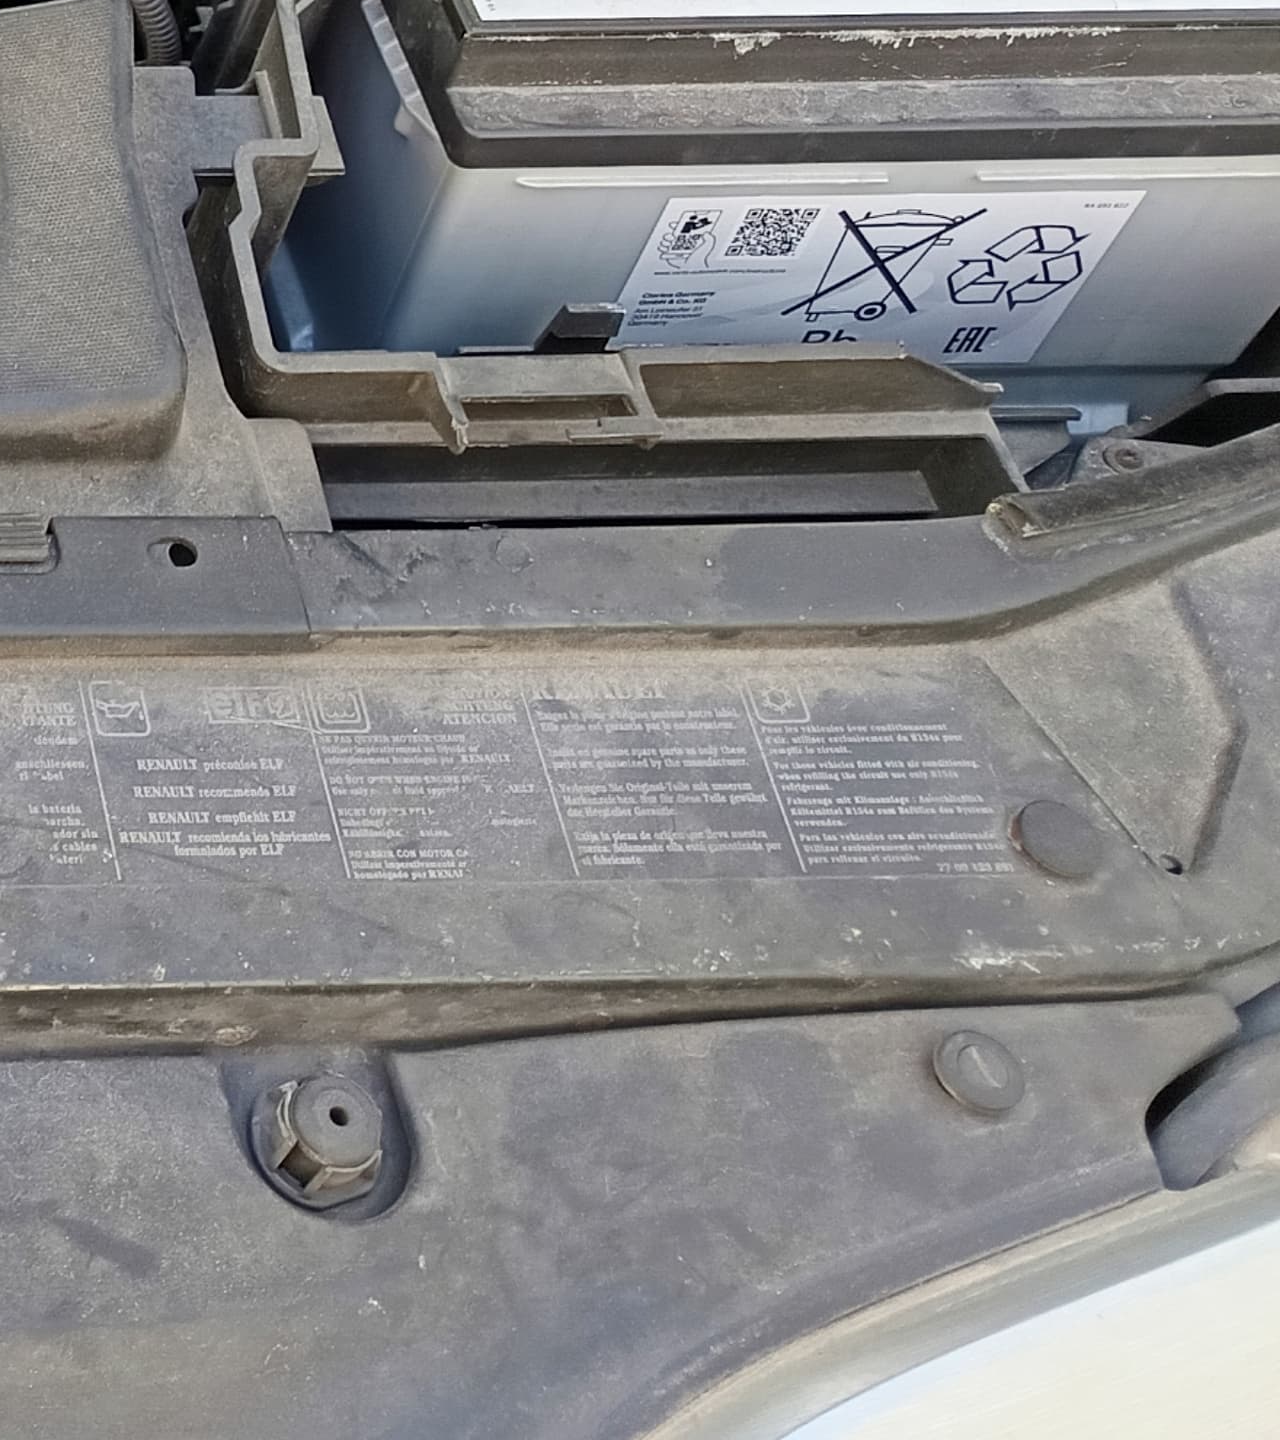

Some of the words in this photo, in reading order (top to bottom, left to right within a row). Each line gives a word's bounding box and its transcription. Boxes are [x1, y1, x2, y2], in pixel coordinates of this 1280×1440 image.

[135, 758, 199, 773] RENAULT
[258, 757, 285, 771] ELF
[132, 785, 195, 799] RENAULT
[270, 784, 298, 798] ELF
[147, 811, 211, 825] RENAULT
[272, 810, 298, 824] ELF
[118, 831, 182, 845] RENAULT
[259, 843, 285, 857] ELF
